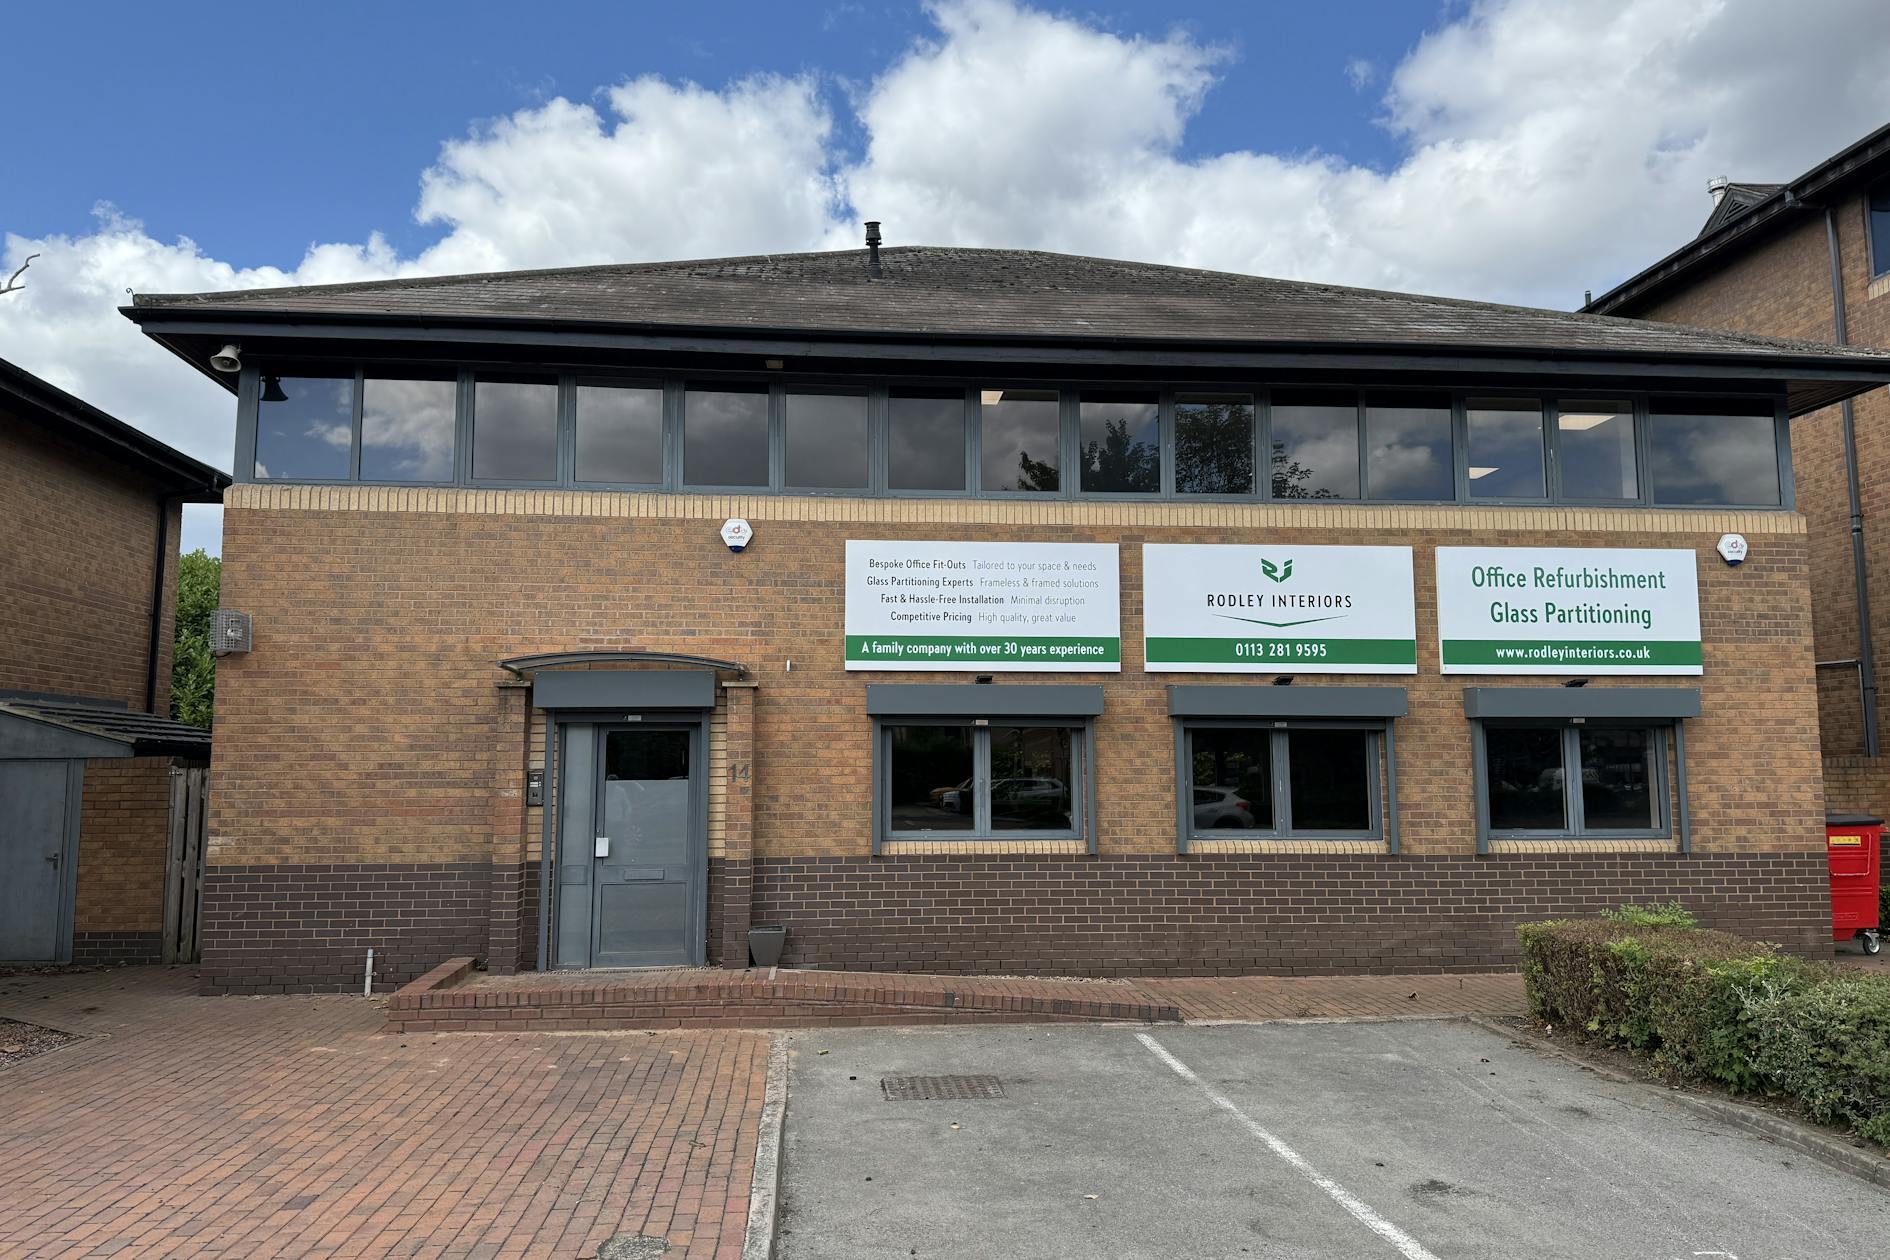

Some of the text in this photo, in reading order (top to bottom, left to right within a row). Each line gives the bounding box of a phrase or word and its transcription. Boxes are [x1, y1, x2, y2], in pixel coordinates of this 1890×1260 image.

[869, 558, 1097, 573] Bespoke Office Fit-Outs Tailored to your space & needs
[867, 575, 1100, 589] Glass Partitioning Experts Frameless & framed solutions
[1471, 565, 1667, 589] Office Refurbishment
[880, 593, 1085, 607] Fast & Hassle-Free Installation Minimal disruption
[1207, 594, 1352, 608] RODLEY INTERIORS
[890, 611, 1077, 625] Competitive Pricing High quality, great value
[1490, 601, 1652, 629] Glass Partitioning
[861, 641, 1105, 658] A family company with over 30 years experience
[1235, 643, 1327, 657] 0113 281 9595
[1496, 645, 1651, 662] www.rodleyinteriors.co.uk
[728, 762, 751, 783] 14
